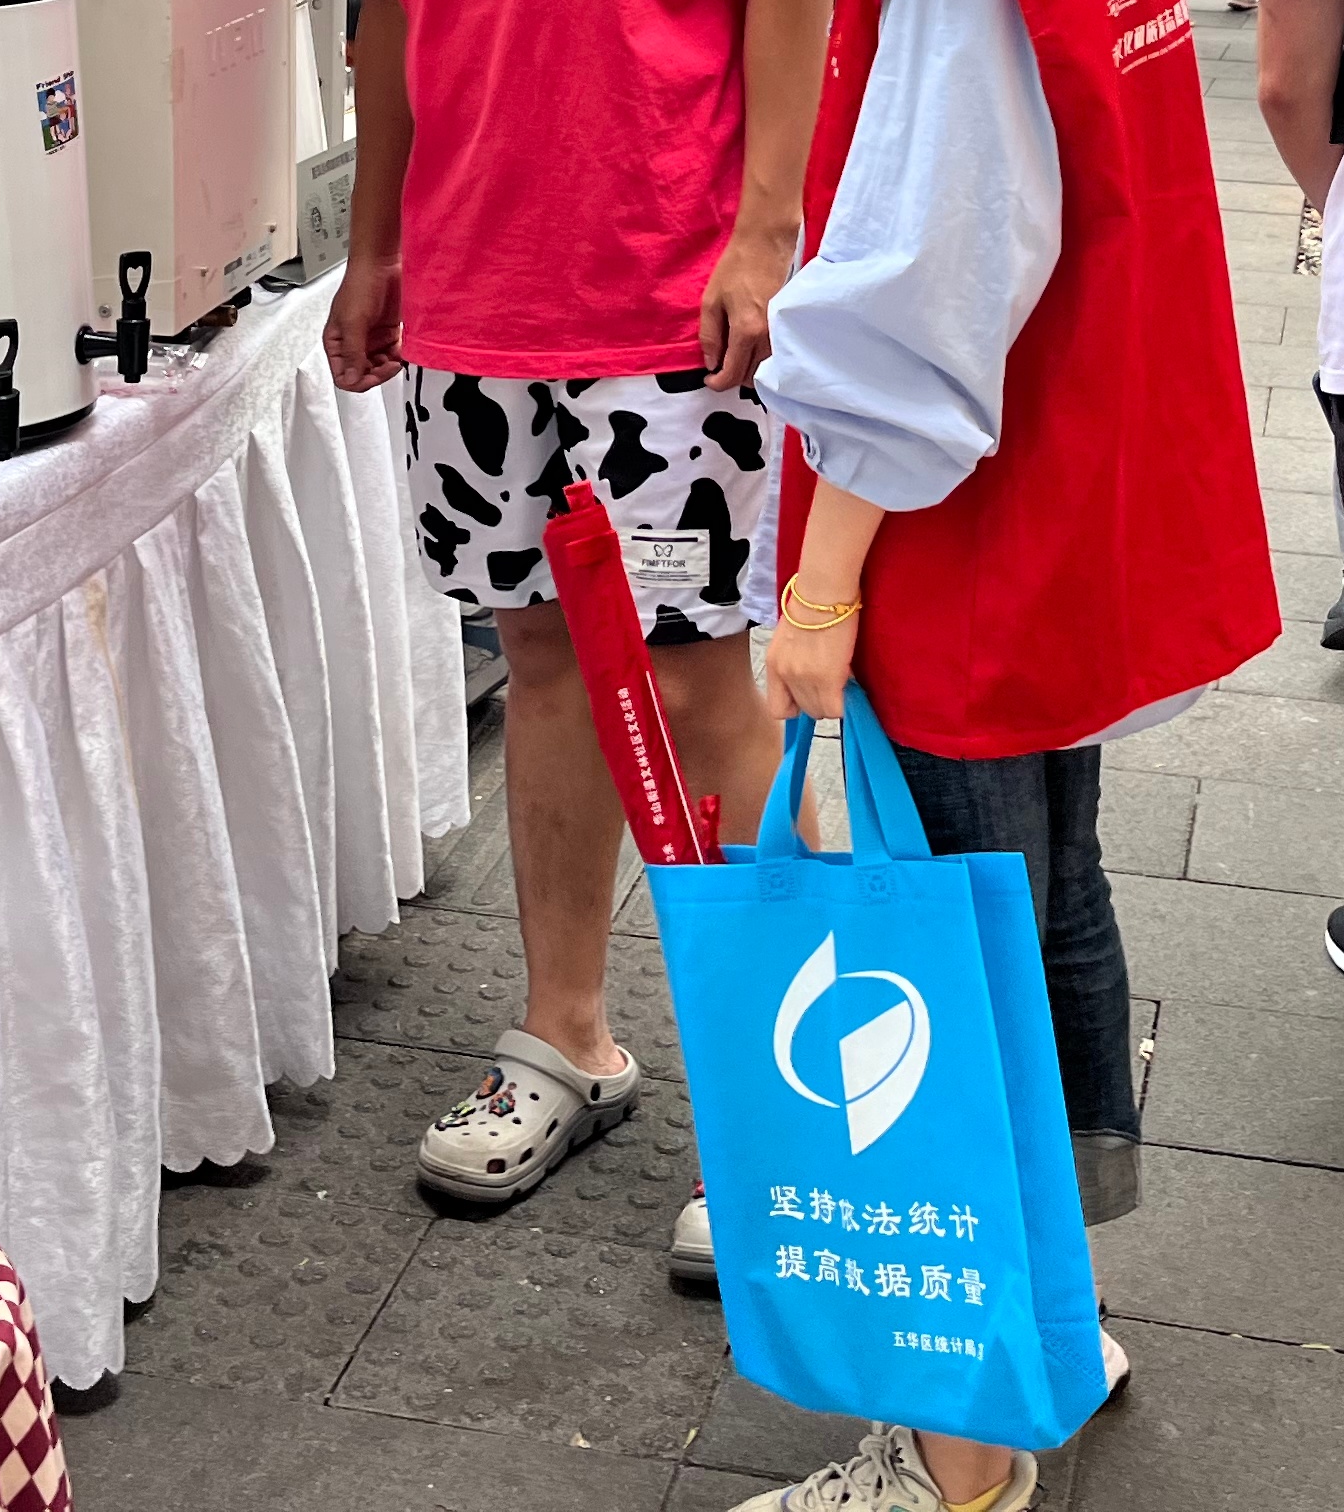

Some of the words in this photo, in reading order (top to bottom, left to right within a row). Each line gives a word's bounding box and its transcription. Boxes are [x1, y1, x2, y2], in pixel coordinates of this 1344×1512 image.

[769, 1184, 980, 1243] 坚持依法统计
[775, 1243, 986, 1307] 提高数据质量
